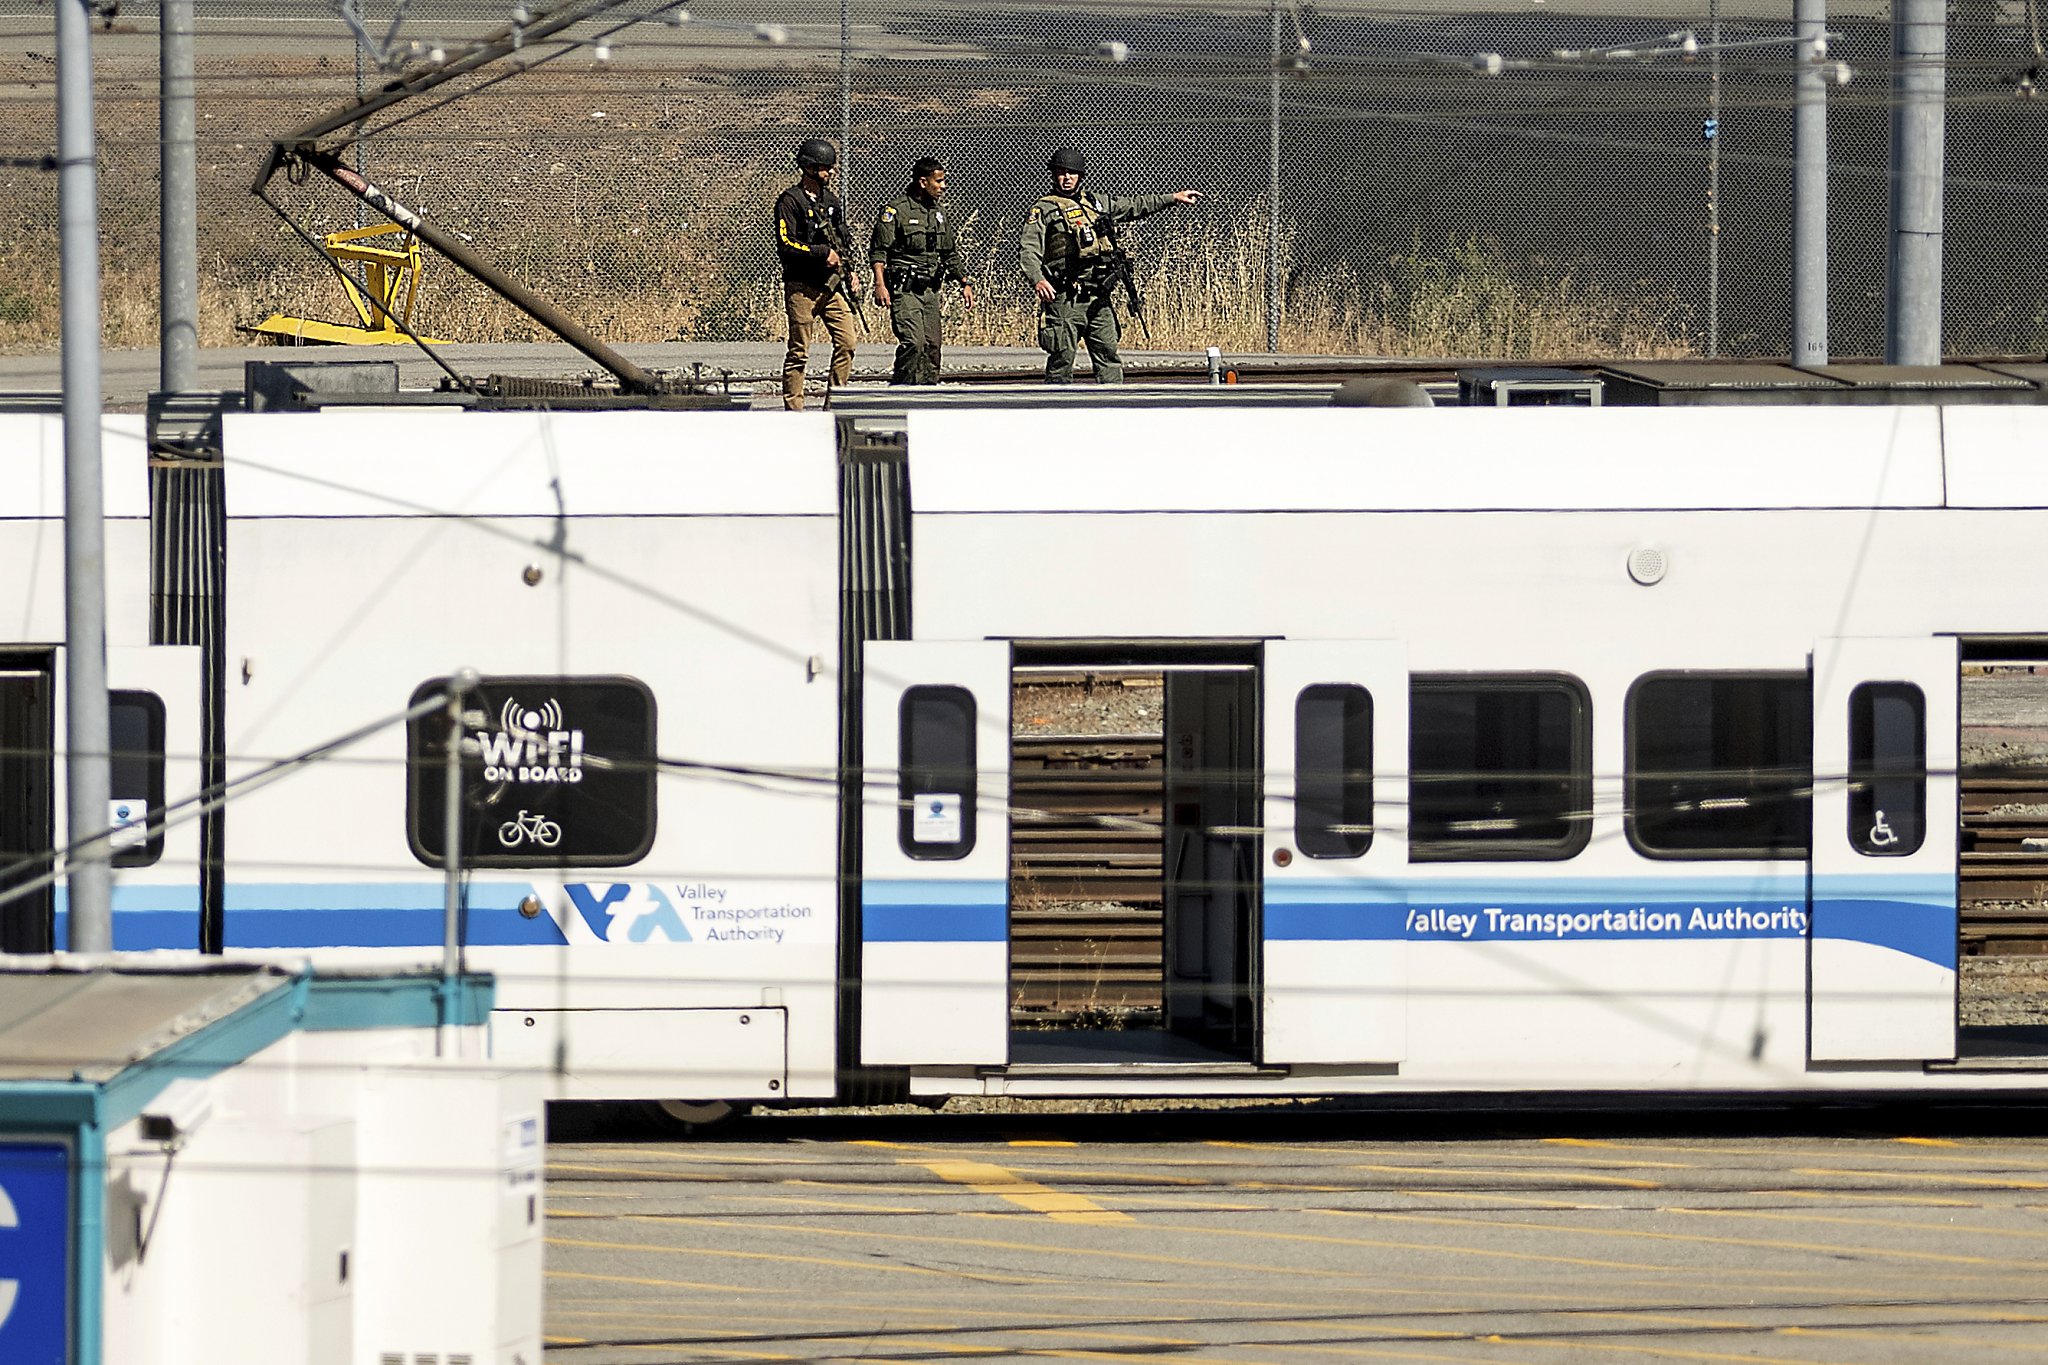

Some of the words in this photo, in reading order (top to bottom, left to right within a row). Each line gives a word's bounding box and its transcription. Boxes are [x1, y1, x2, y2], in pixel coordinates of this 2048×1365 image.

[484, 766, 514, 782] ON
[519, 766, 583, 783] BOARD
[677, 884, 727, 901] Valley
[691, 904, 811, 922] Transportation
[1483, 907, 1681, 938] Transportation
[1688, 906, 1809, 935] Authority
[706, 926, 784, 943] Authority
